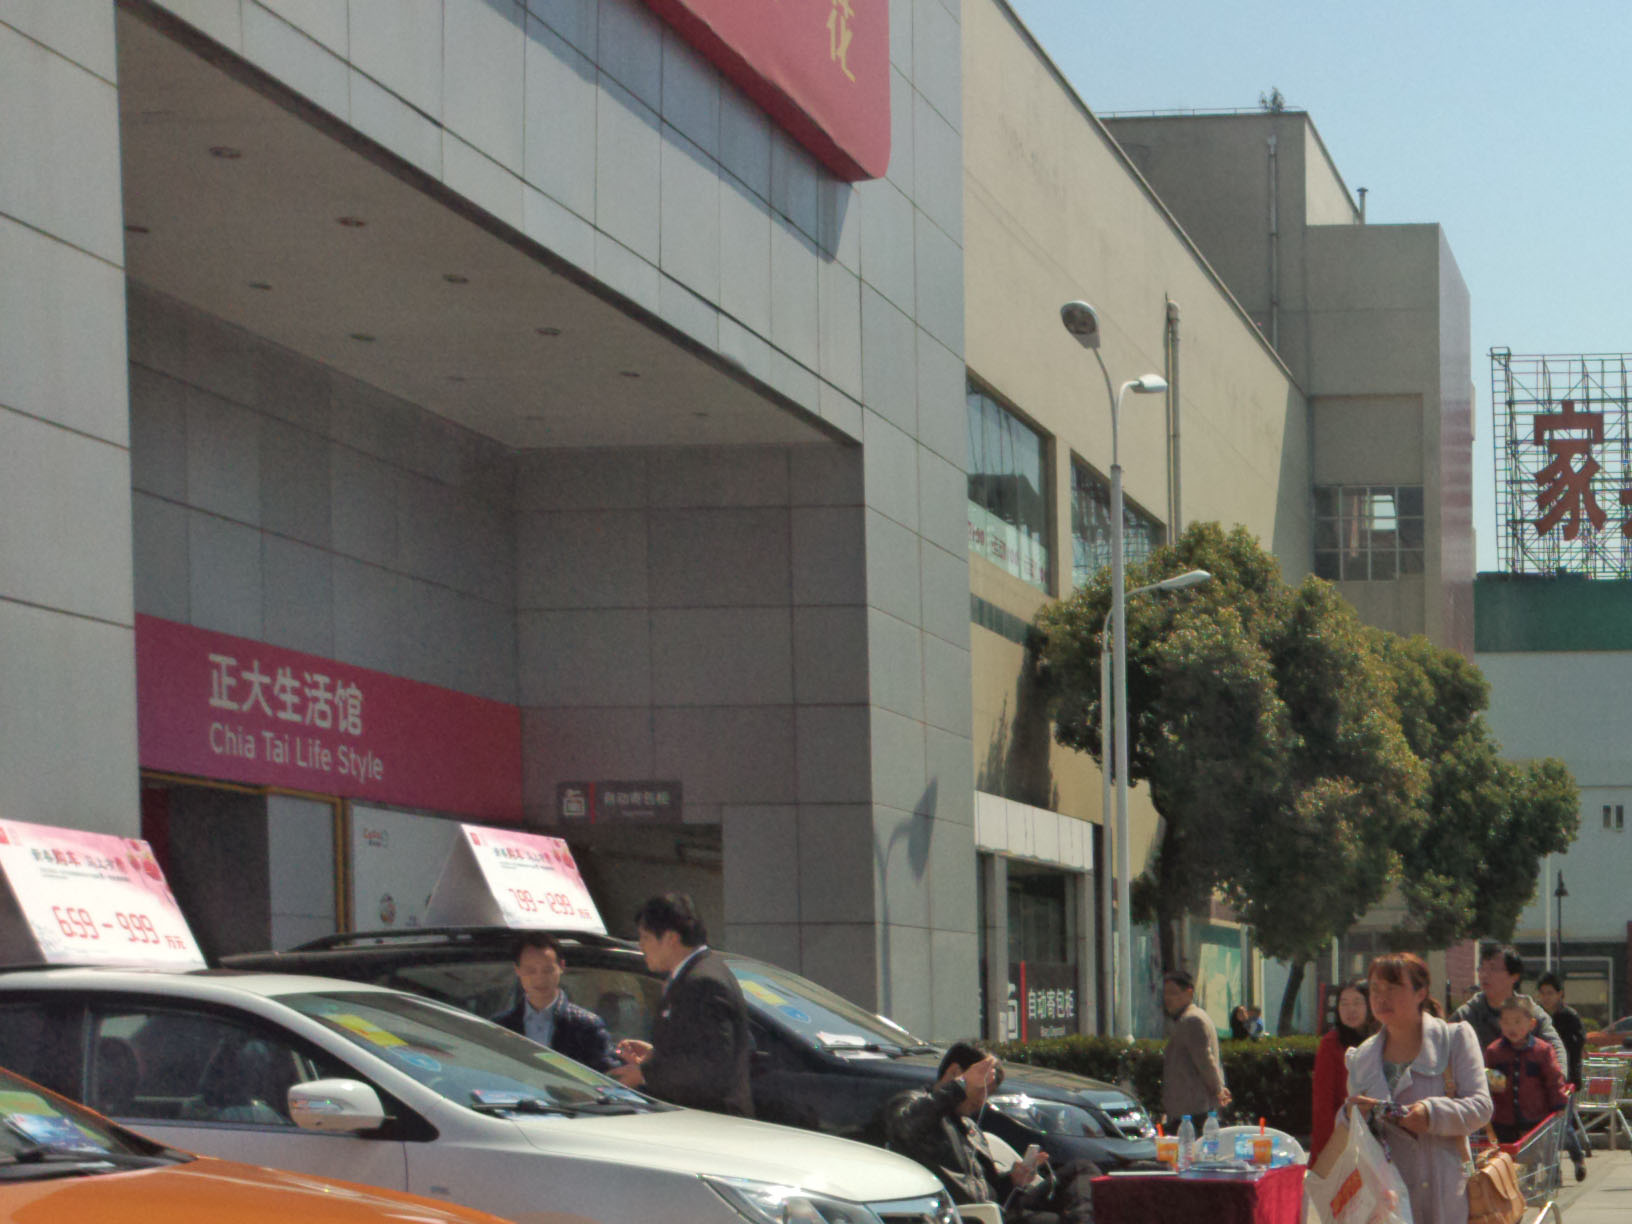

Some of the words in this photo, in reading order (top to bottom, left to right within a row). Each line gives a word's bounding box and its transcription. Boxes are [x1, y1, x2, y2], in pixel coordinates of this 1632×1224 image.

[208, 653, 365, 736] 正大生活馆
[209, 721, 256, 759] Chia
[261, 730, 291, 764] Tai
[296, 736, 333, 772] Life
[337, 744, 384, 783] Style
